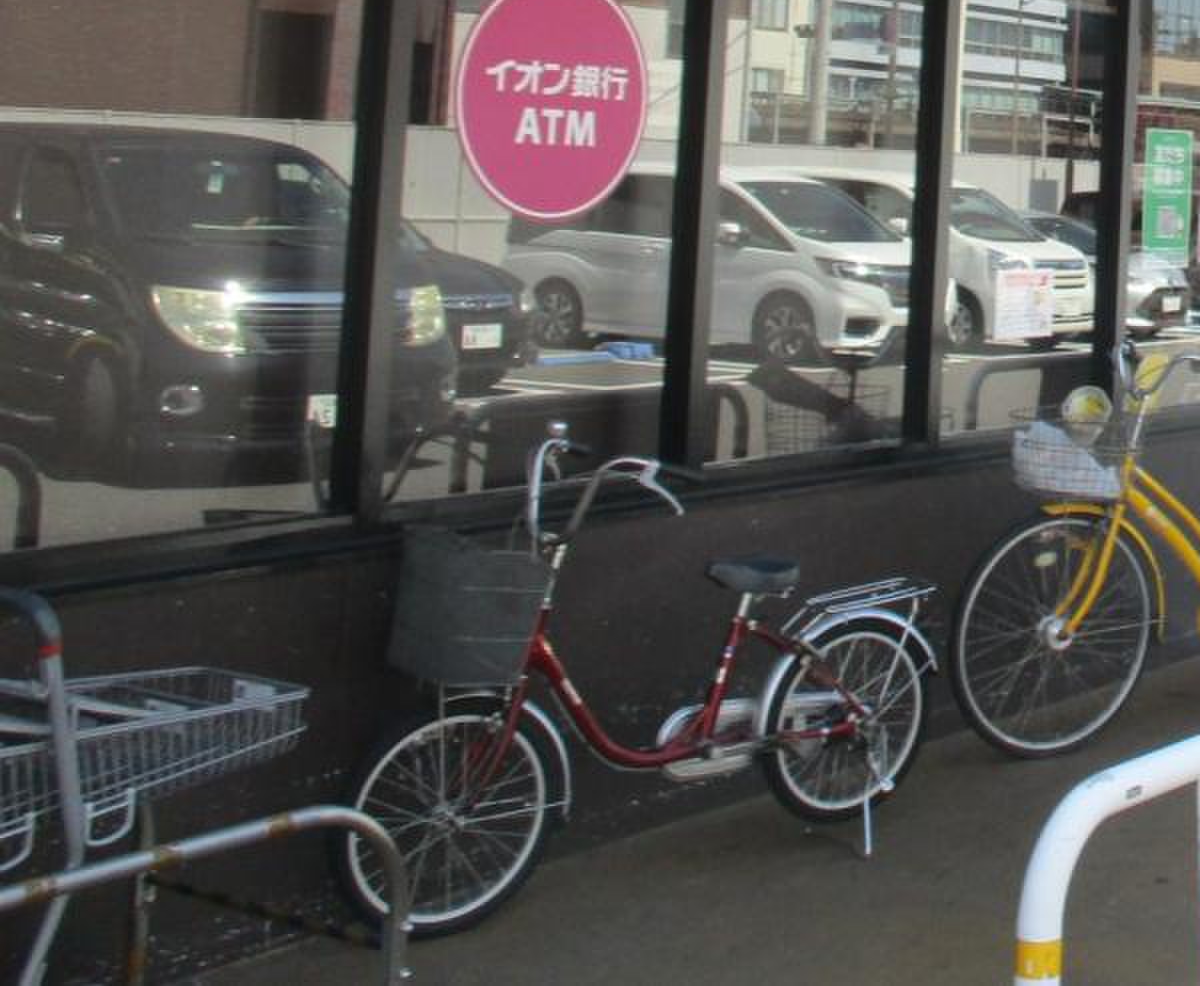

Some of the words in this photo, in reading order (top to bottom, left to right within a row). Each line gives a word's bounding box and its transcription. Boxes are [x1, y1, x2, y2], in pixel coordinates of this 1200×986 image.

[485, 60, 629, 100] イオン銀行
[514, 107, 597, 147] ATM
